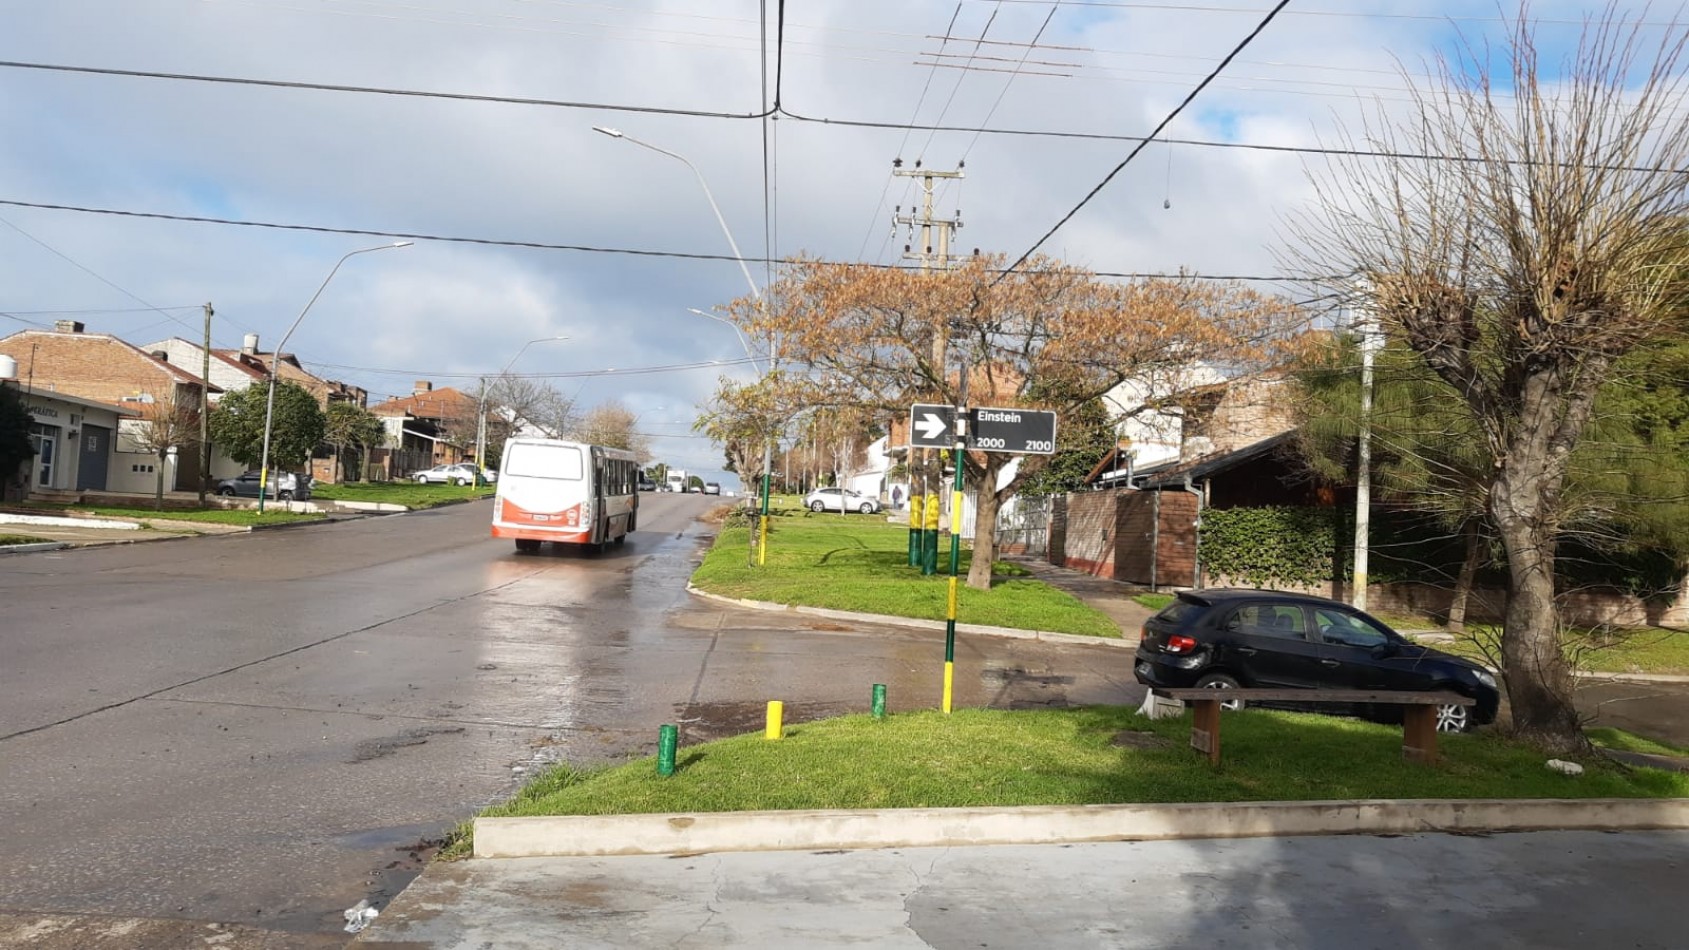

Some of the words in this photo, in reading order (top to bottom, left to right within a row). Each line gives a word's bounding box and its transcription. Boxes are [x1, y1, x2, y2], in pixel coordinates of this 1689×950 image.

[978, 411, 1021, 423] Einstein
[977, 437, 1005, 448] 2000
[1025, 440, 1052, 451] 2100
